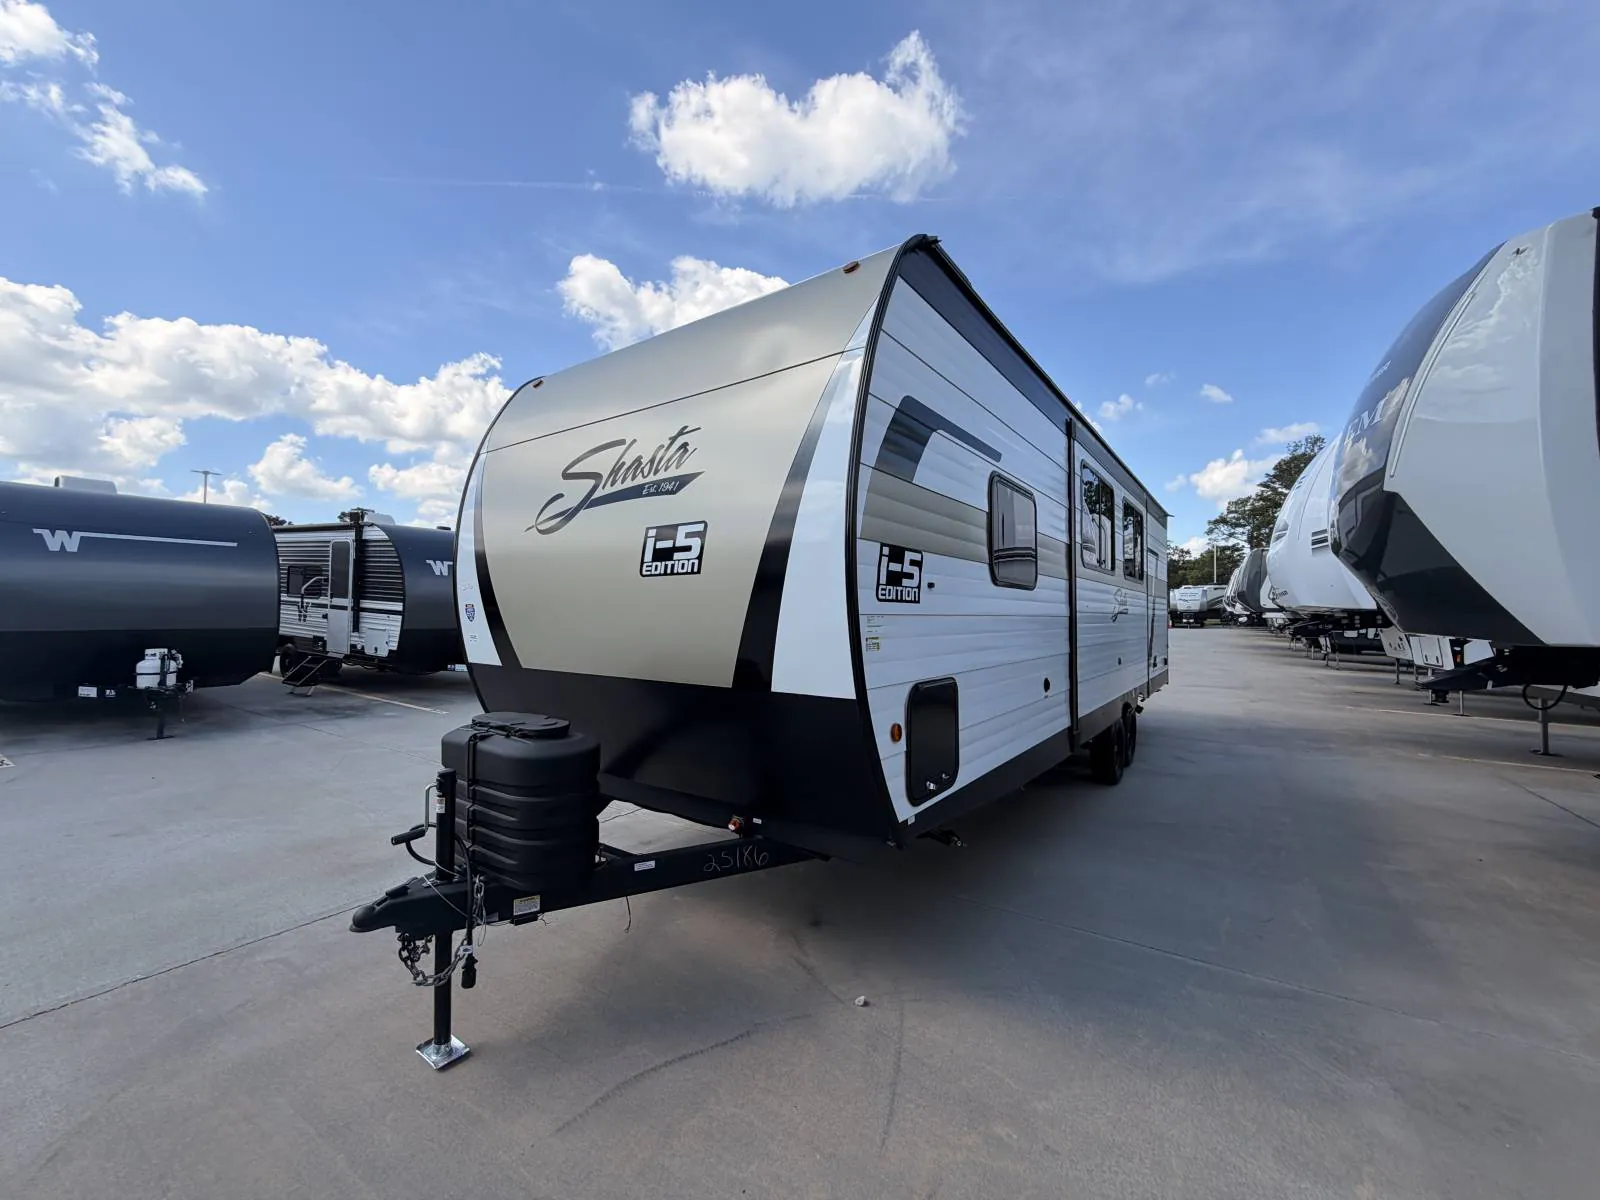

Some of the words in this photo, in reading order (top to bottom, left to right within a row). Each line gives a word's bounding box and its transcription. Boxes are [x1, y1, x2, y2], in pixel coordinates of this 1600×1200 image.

[528, 425, 702, 535] Shasta
[659, 481, 679, 493] 1941
[642, 559, 699, 575] EDITION
[879, 586, 919, 601] EDITION
[704, 845, 769, 872] 25186
